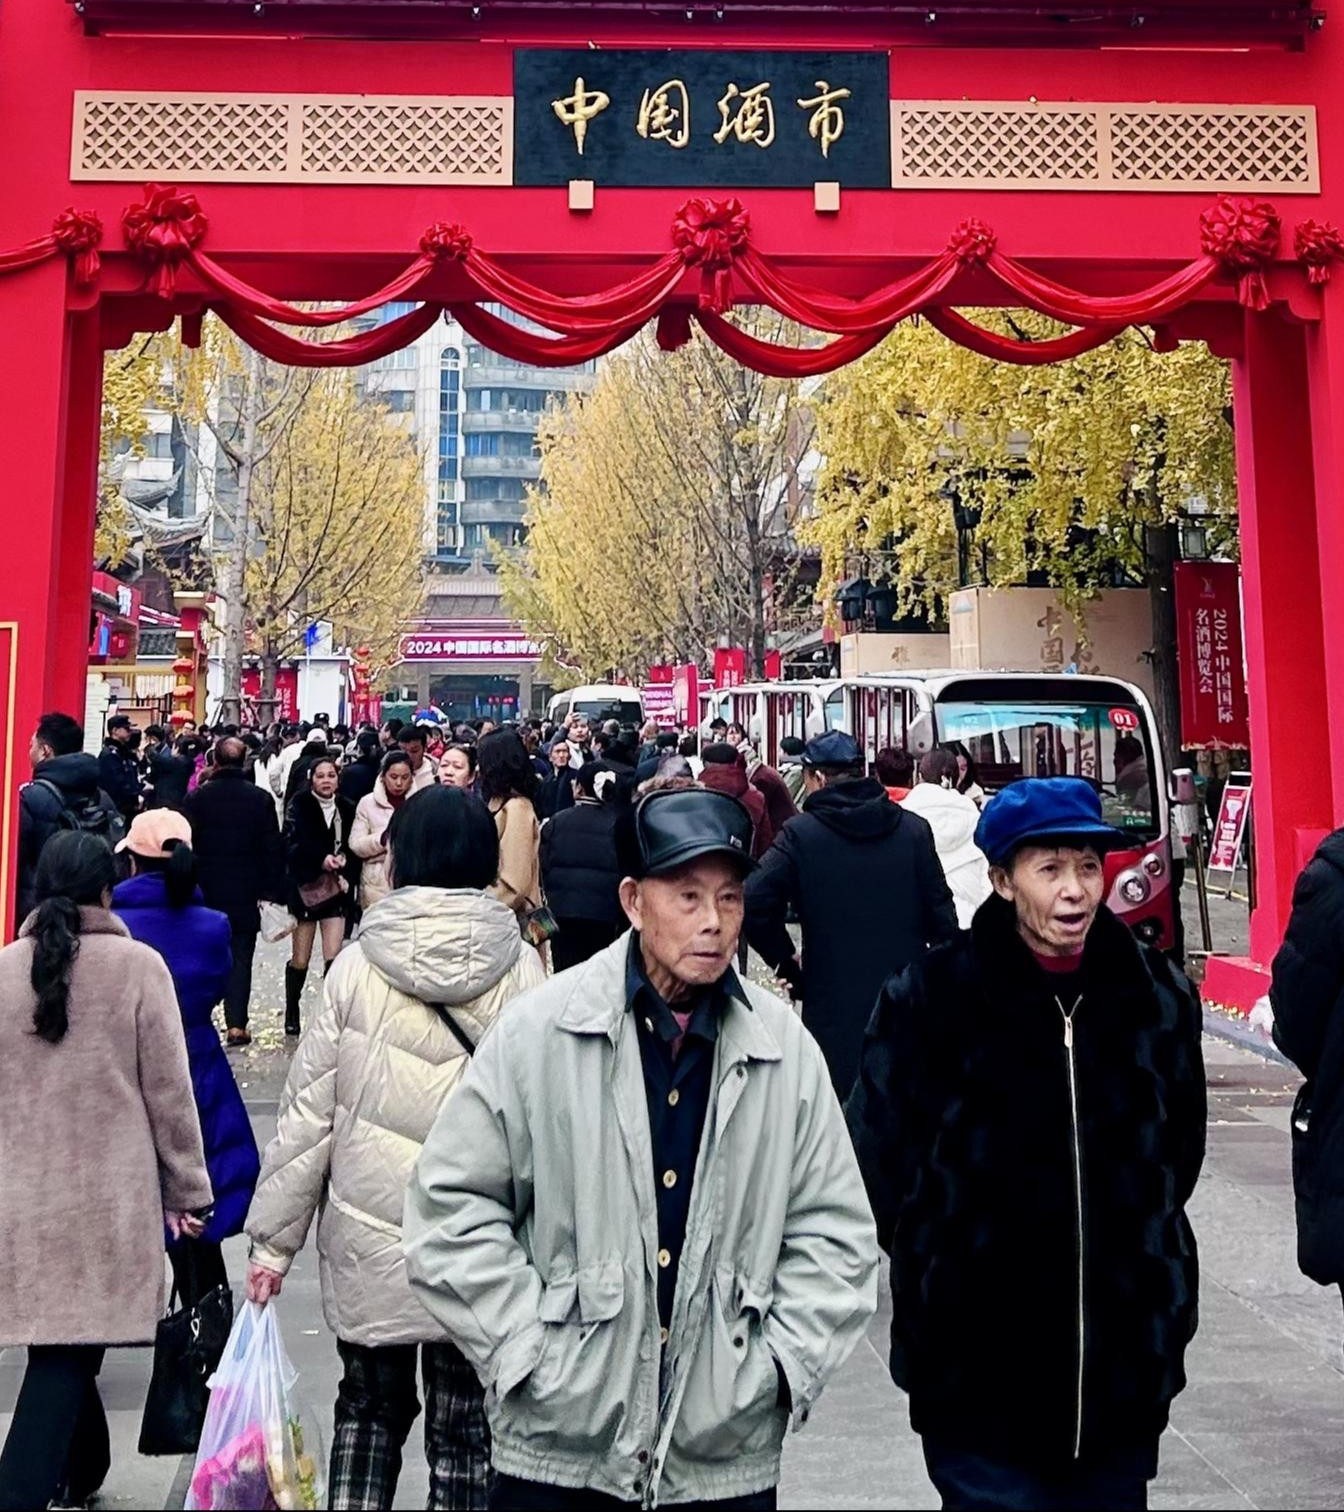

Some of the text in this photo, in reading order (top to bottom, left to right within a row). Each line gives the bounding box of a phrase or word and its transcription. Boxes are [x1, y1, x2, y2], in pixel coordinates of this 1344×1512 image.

[551, 76, 851, 160] 中国酒市
[1113, 713, 1133, 726] 01
